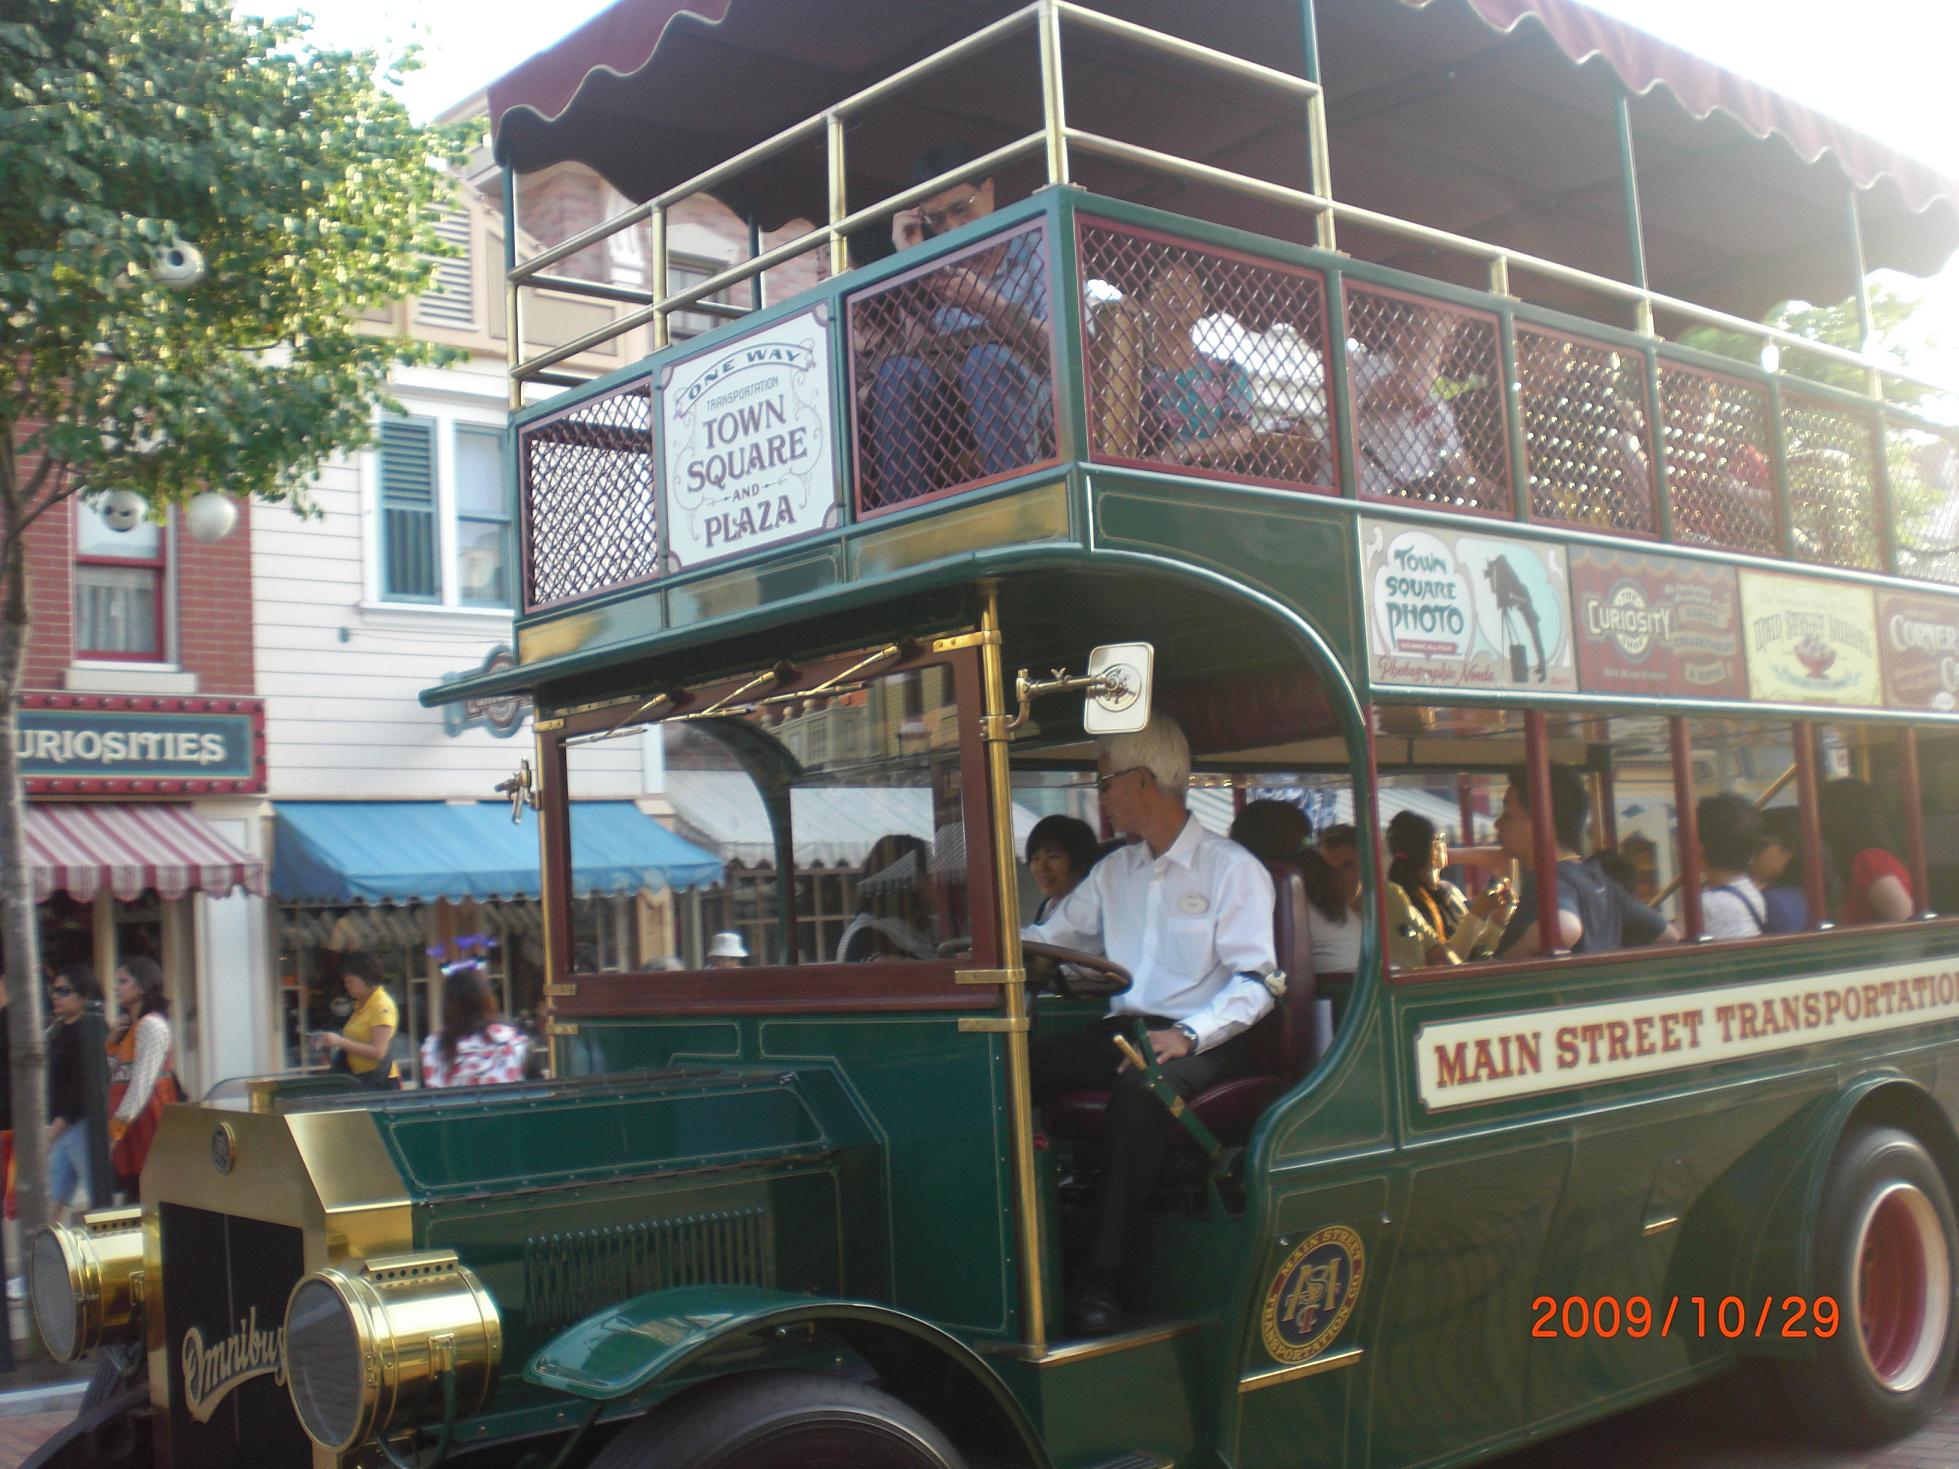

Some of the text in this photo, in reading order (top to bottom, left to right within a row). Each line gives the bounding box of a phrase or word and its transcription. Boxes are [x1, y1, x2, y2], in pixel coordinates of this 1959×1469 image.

[688, 348, 801, 400] ONE WAY
[706, 375, 779, 411] TRANSPORTATION
[702, 393, 786, 449] TOWN
[687, 426, 808, 493] SQUARE
[732, 483, 760, 502] AND
[704, 495, 797, 548] PLAZA
[1385, 576, 1457, 600] SQUARE
[1385, 602, 1464, 649] PHOTO
[1588, 600, 1669, 640] CURIOSITY
[14, 729, 226, 764] URIOSITIES
[1435, 971, 1959, 1088] MAIN STREET TRANSPORTATIO
[182, 1306, 287, 1423] Omnibus
